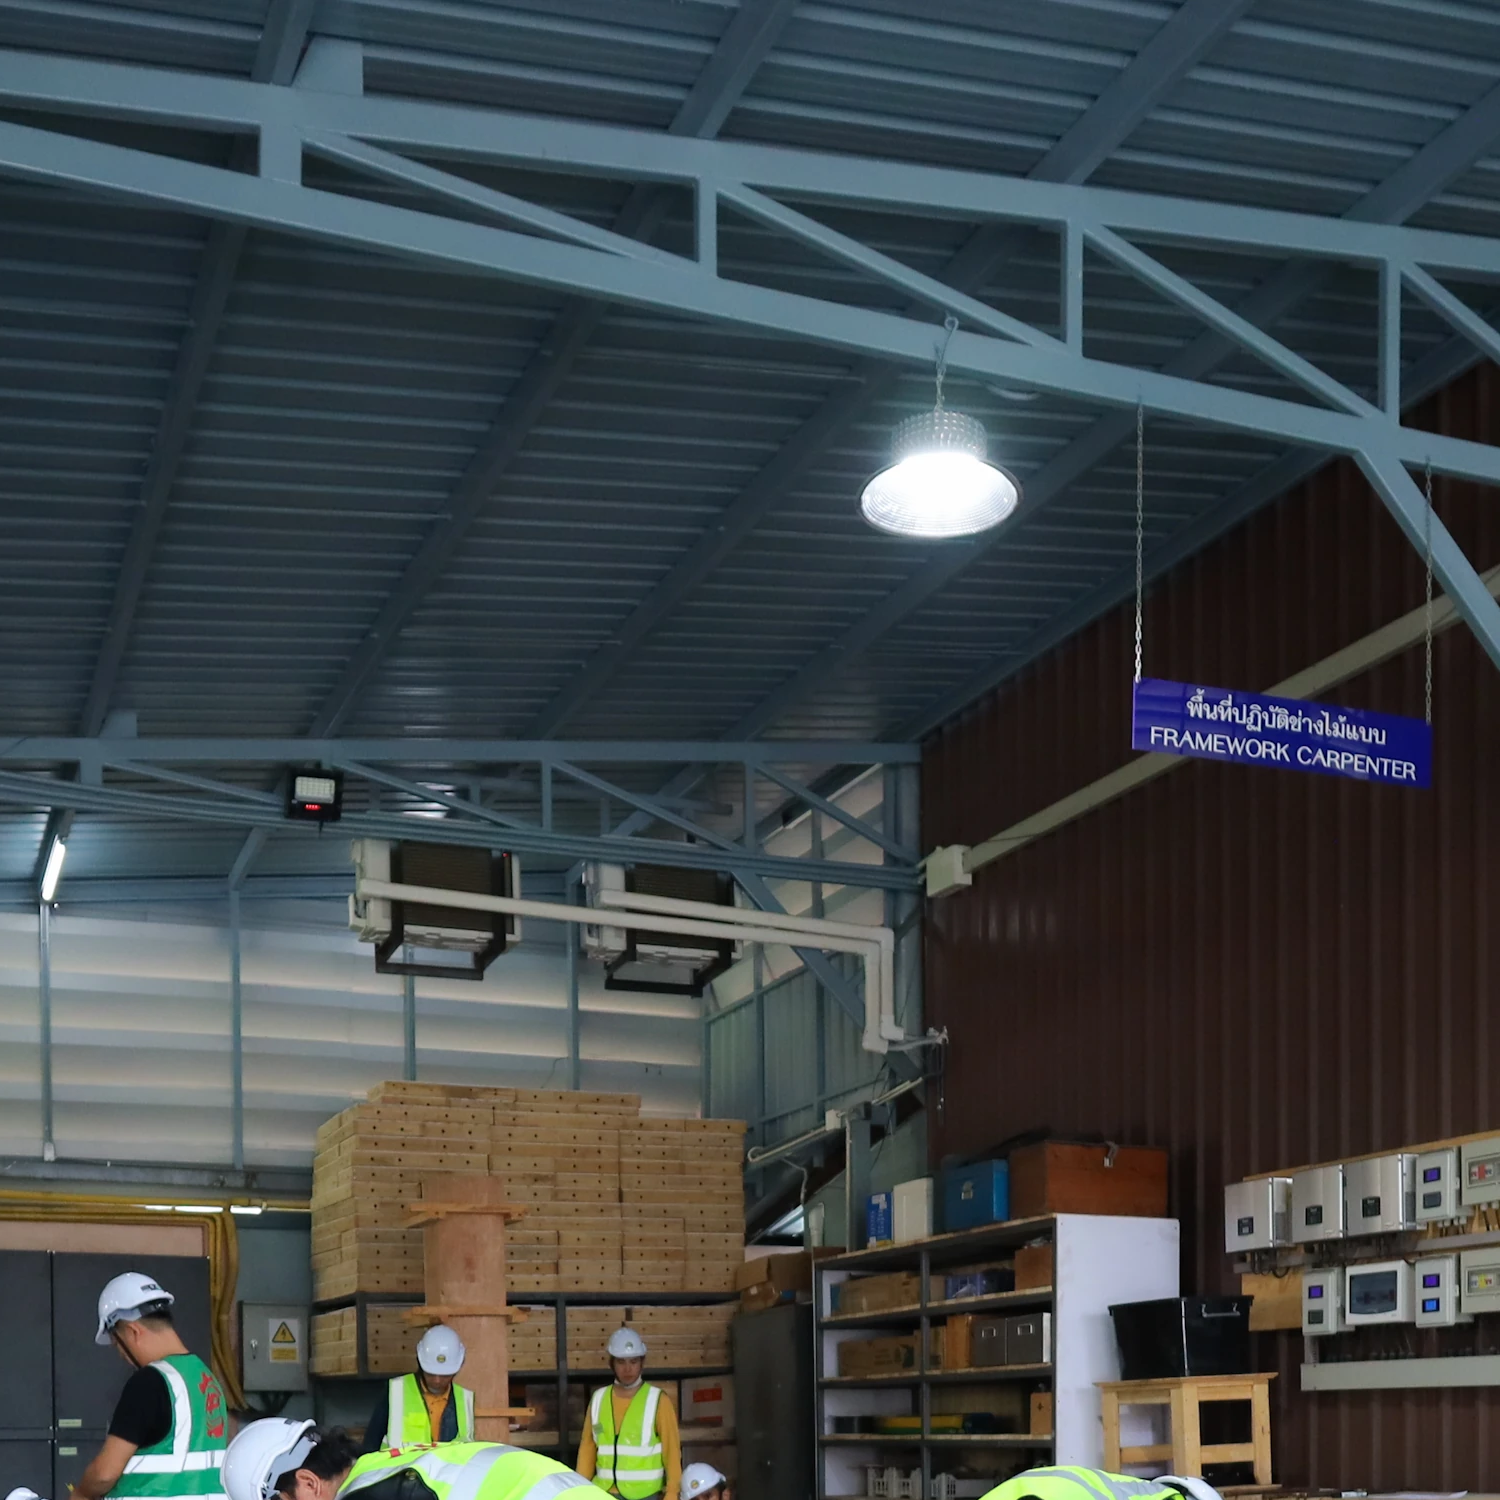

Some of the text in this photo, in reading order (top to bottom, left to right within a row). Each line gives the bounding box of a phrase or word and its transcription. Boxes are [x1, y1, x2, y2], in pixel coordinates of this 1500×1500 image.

[1186, 689, 1387, 745] พื้นที่ปฏิบัติช่างไม้แบบ
[1150, 726, 1417, 780] FRAMEWORK CARPENTER
